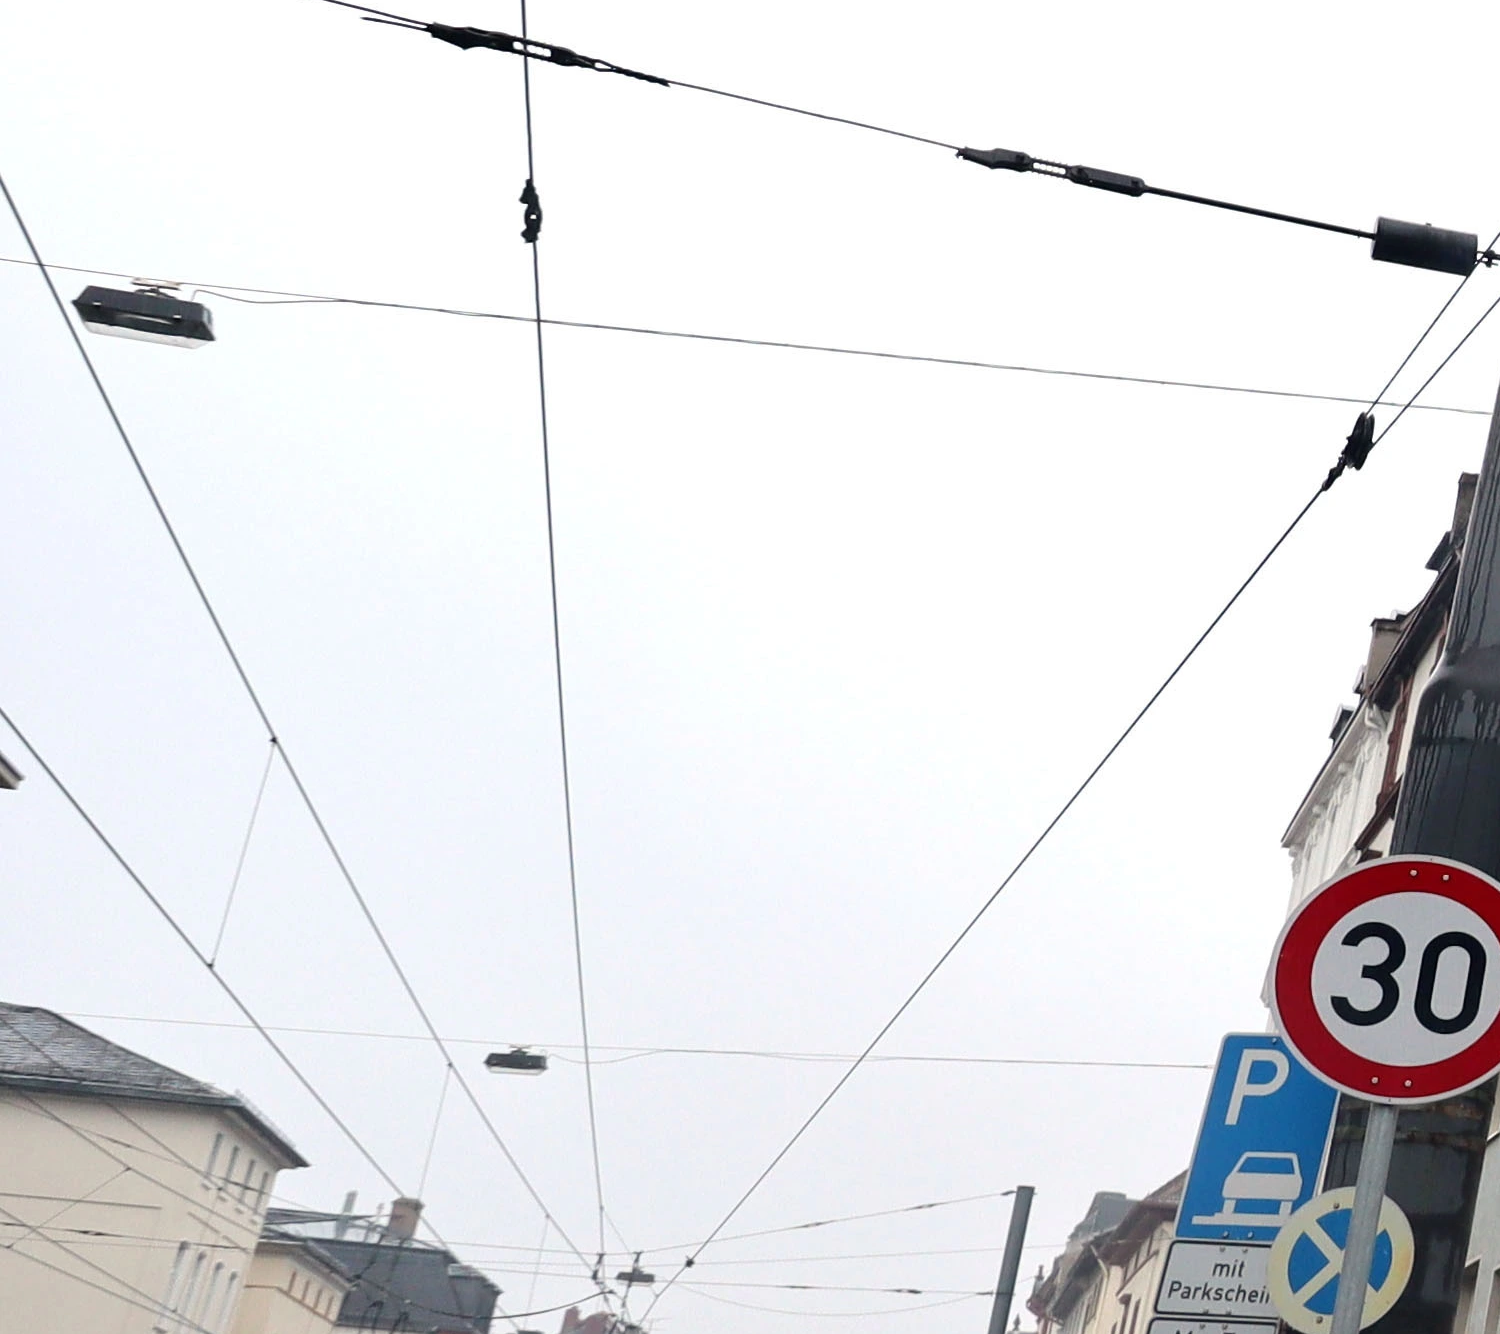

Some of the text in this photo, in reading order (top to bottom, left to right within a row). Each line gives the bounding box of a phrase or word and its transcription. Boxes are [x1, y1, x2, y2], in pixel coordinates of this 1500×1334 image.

[1330, 922, 1487, 1034] 30
[1224, 1049, 1290, 1125] P
[1212, 1260, 1245, 1278] mit
